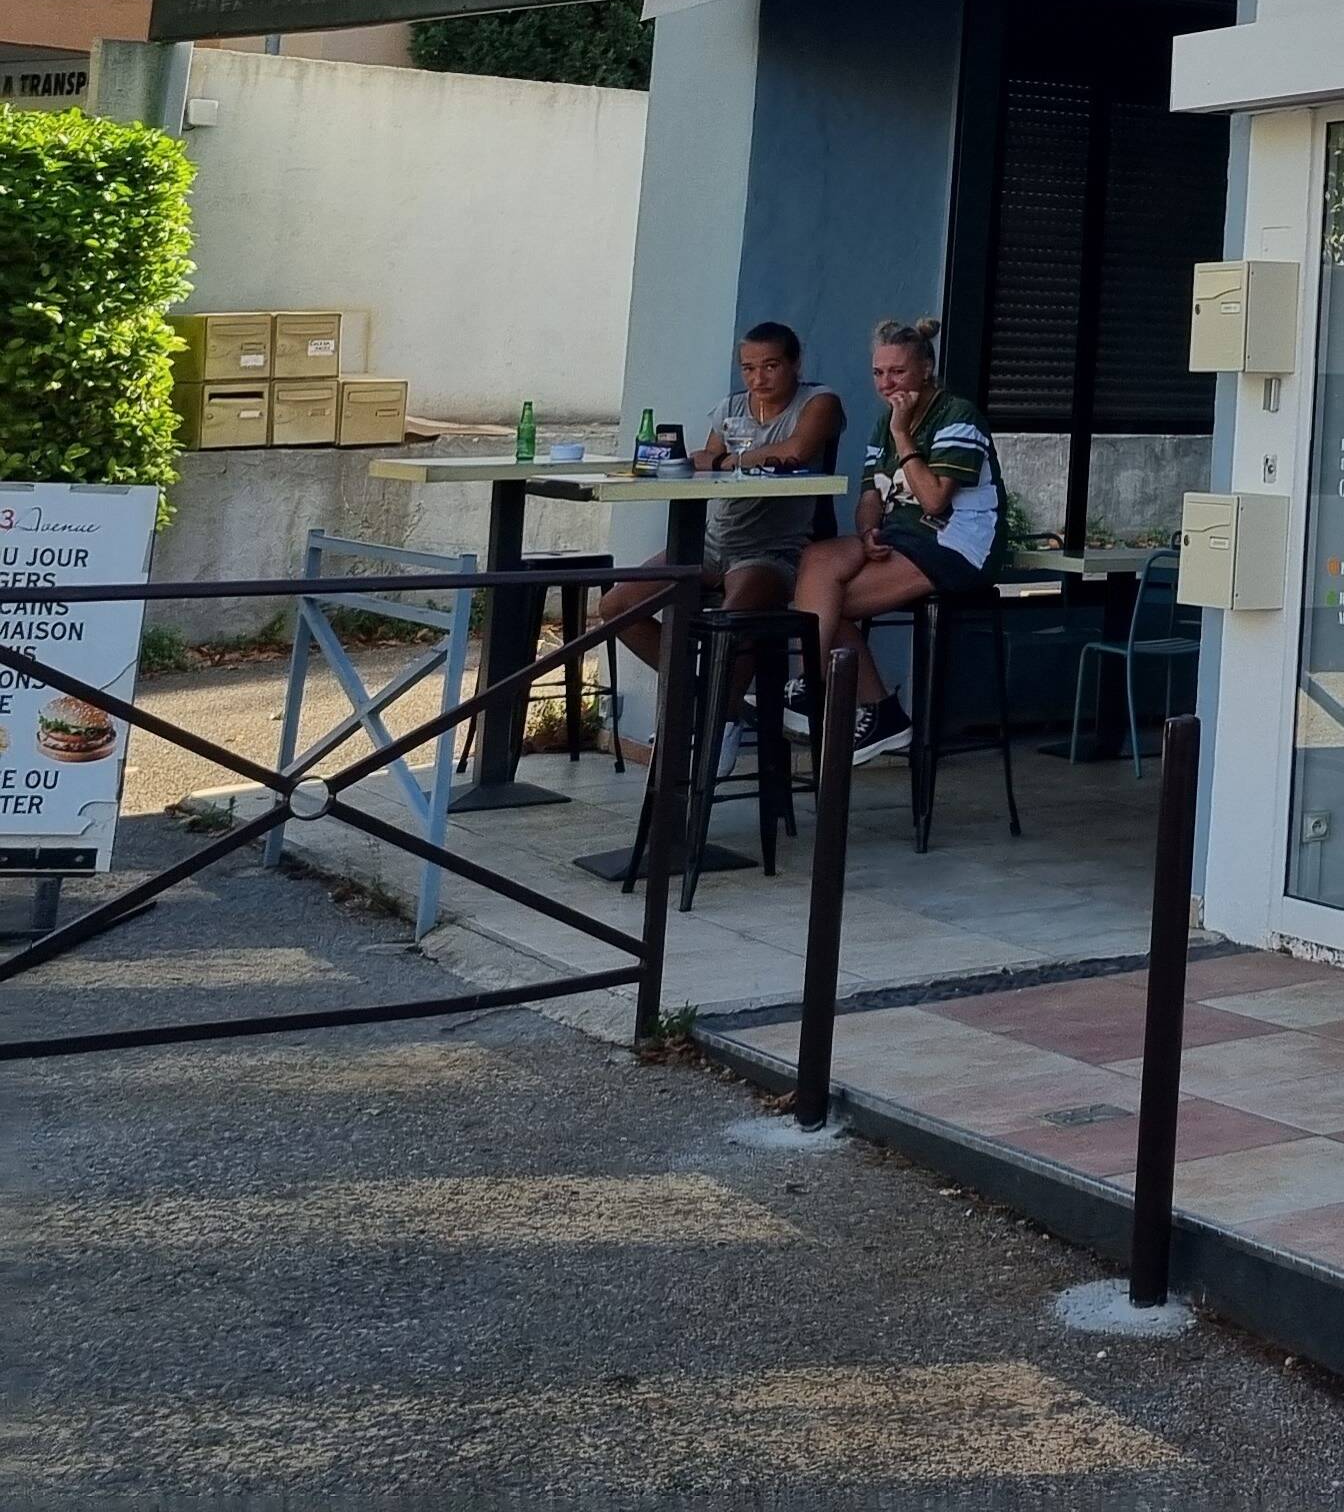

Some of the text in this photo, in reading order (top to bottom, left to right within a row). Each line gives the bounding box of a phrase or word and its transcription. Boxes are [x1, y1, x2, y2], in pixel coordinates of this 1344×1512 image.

[20, 71, 89, 96] TRANSP
[25, 547, 89, 568] JOUR
[25, 769, 60, 789] OU
